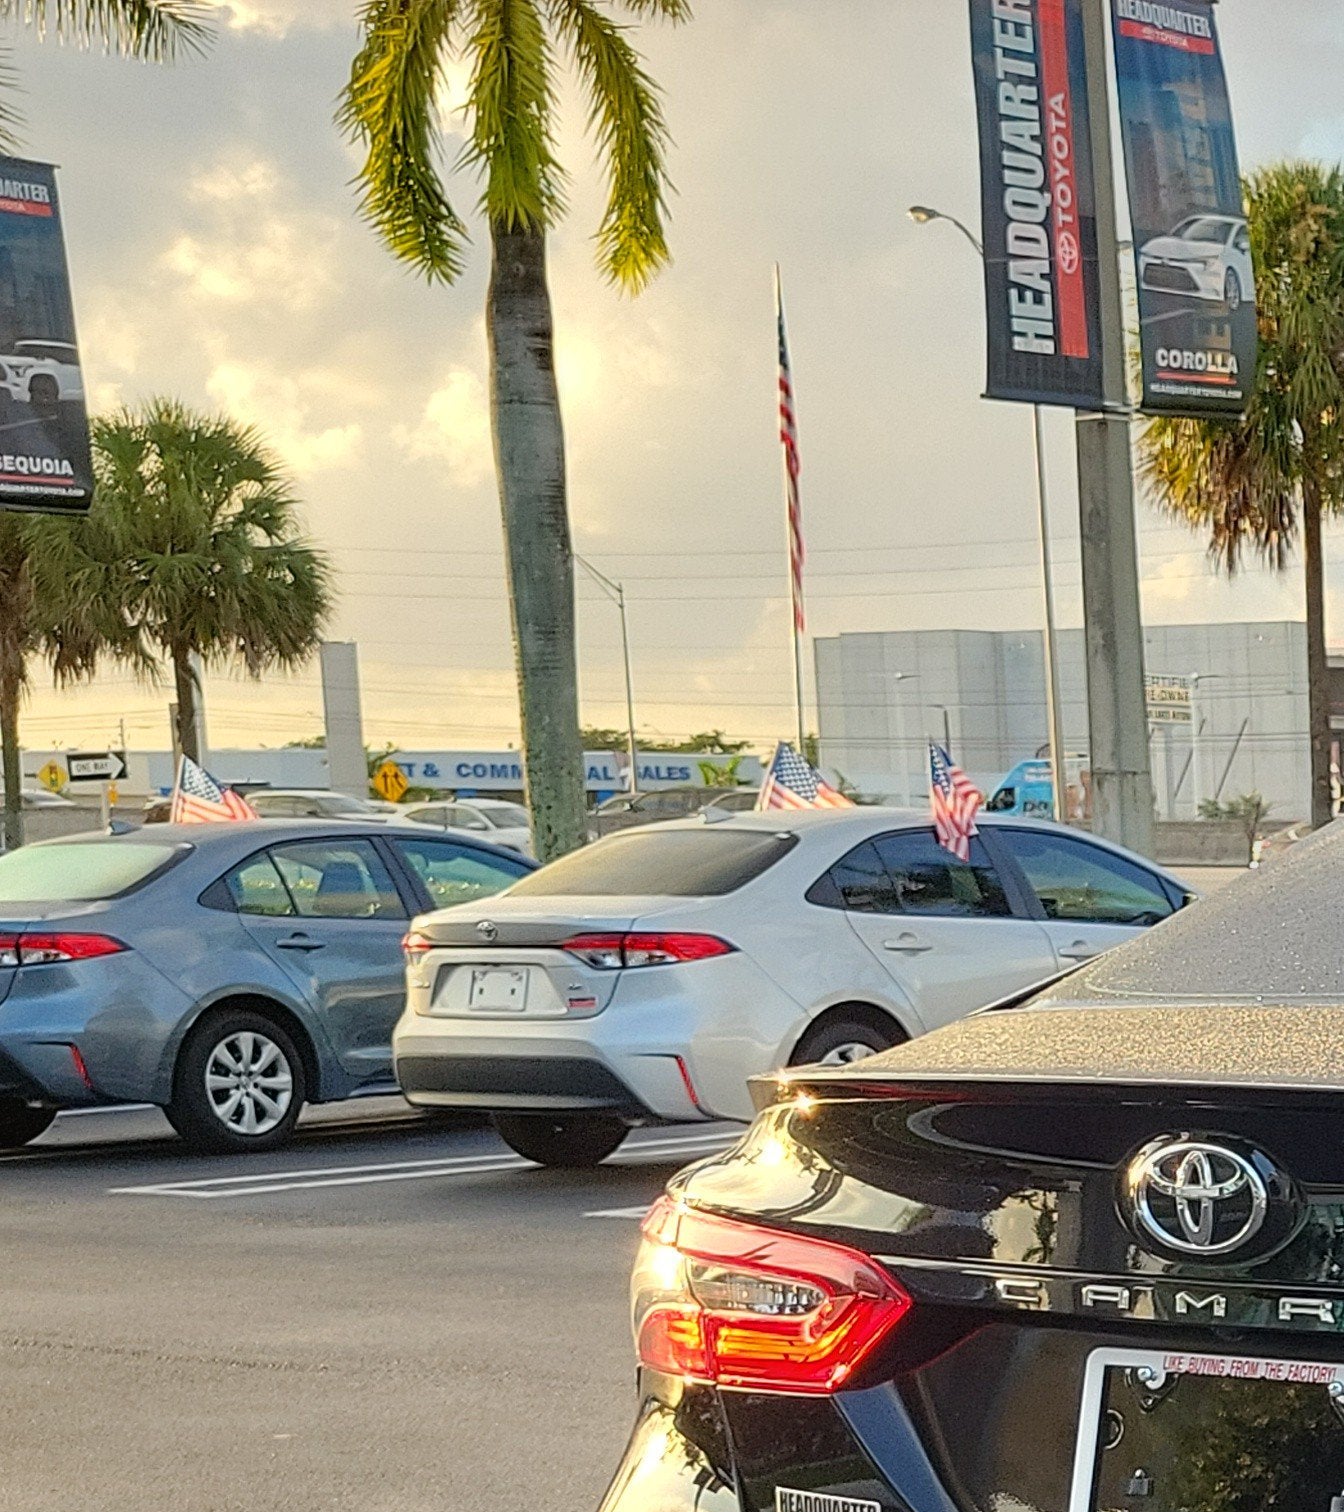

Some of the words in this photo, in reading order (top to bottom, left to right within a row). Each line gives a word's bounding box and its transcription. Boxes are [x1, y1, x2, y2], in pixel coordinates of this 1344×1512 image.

[1117, 0, 1212, 38] HEADQUARTER
[1050, 92, 1074, 223] TOYOTA
[992, 0, 1055, 355] HEADQUARTER
[1155, 347, 1239, 375] COROLLA
[0, 454, 74, 476] EQUOIA
[75, 764, 92, 773] ONE
[1163, 1355, 1183, 1371] LIKE
[1188, 1357, 1226, 1375] BUYING
[1230, 1359, 1259, 1377] FROM
[1264, 1362, 1284, 1379] THE
